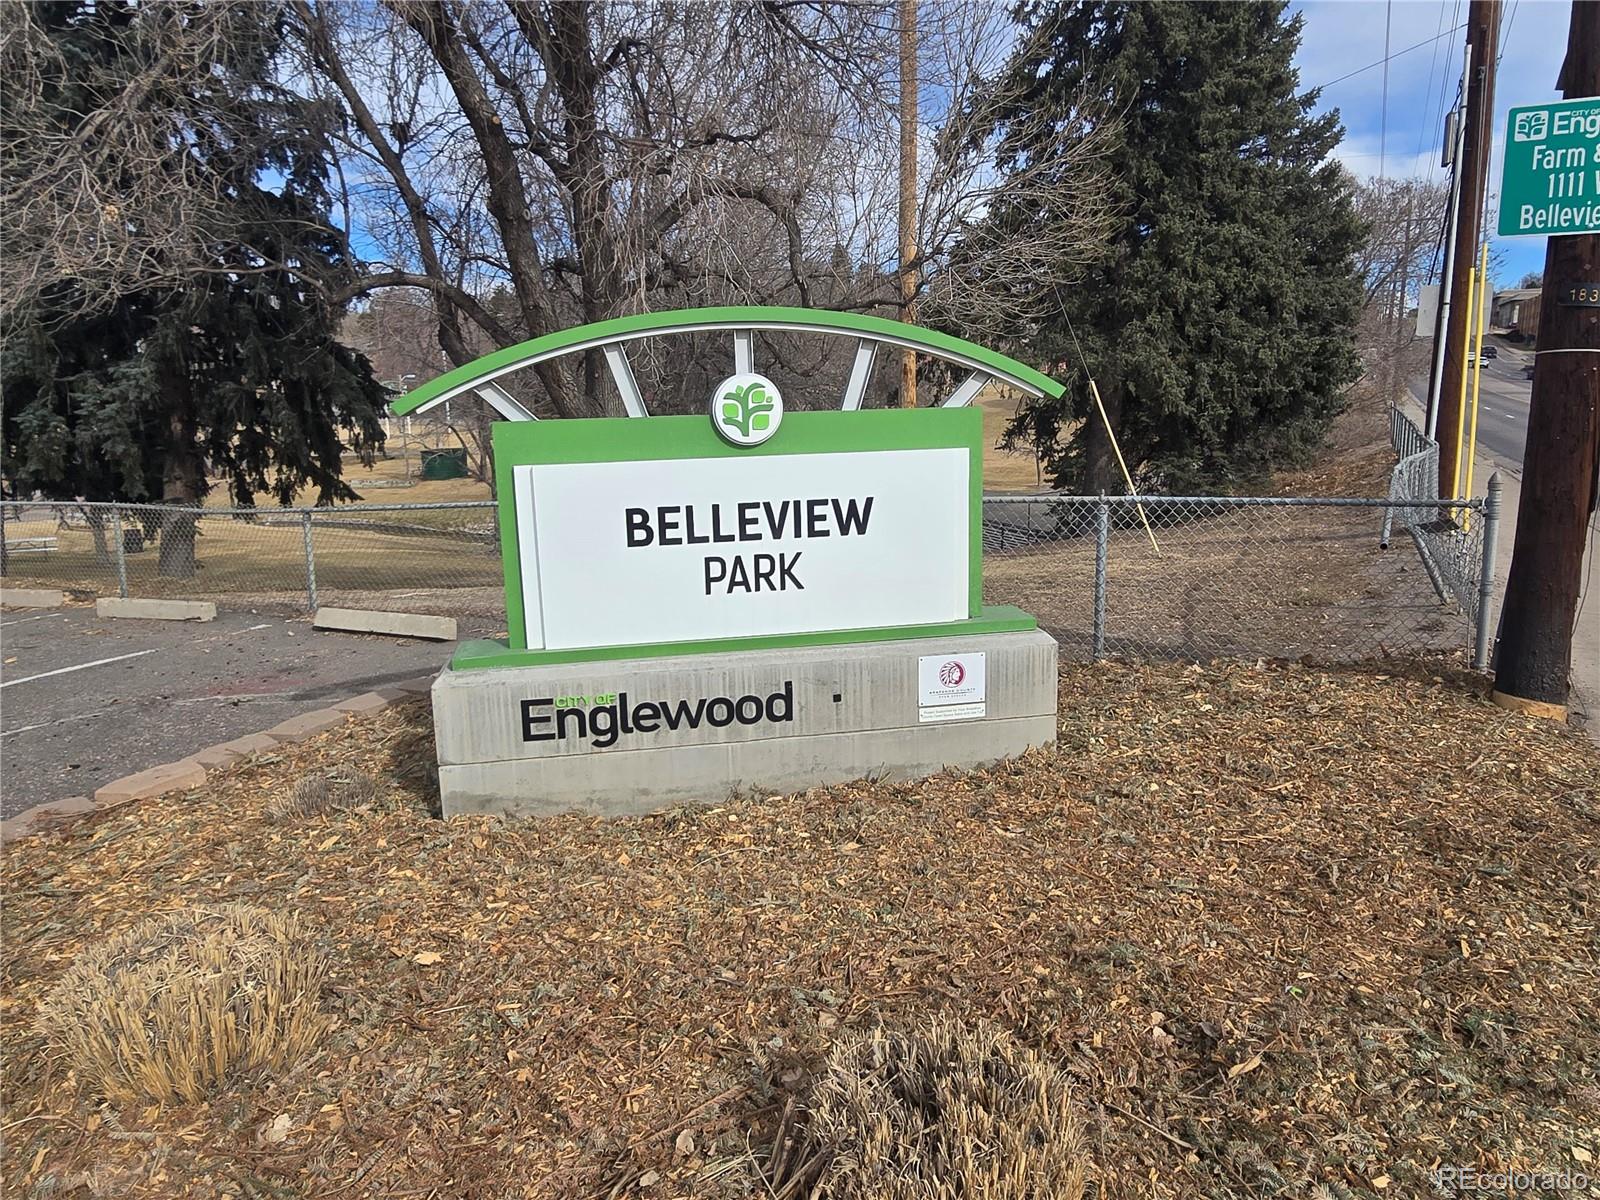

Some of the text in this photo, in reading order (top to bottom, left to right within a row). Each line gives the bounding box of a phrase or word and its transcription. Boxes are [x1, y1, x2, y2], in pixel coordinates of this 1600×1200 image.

[1532, 145, 1586, 170] Farm
[1548, 171, 1585, 198] 1111
[1519, 200, 1600, 230] Bellevie
[1569, 288, 1599, 302] 183
[625, 496, 874, 548] BELLEVIEW
[704, 551, 804, 595] PARK
[520, 680, 793, 748] Englewood
[555, 692, 617, 708] CITY OF
